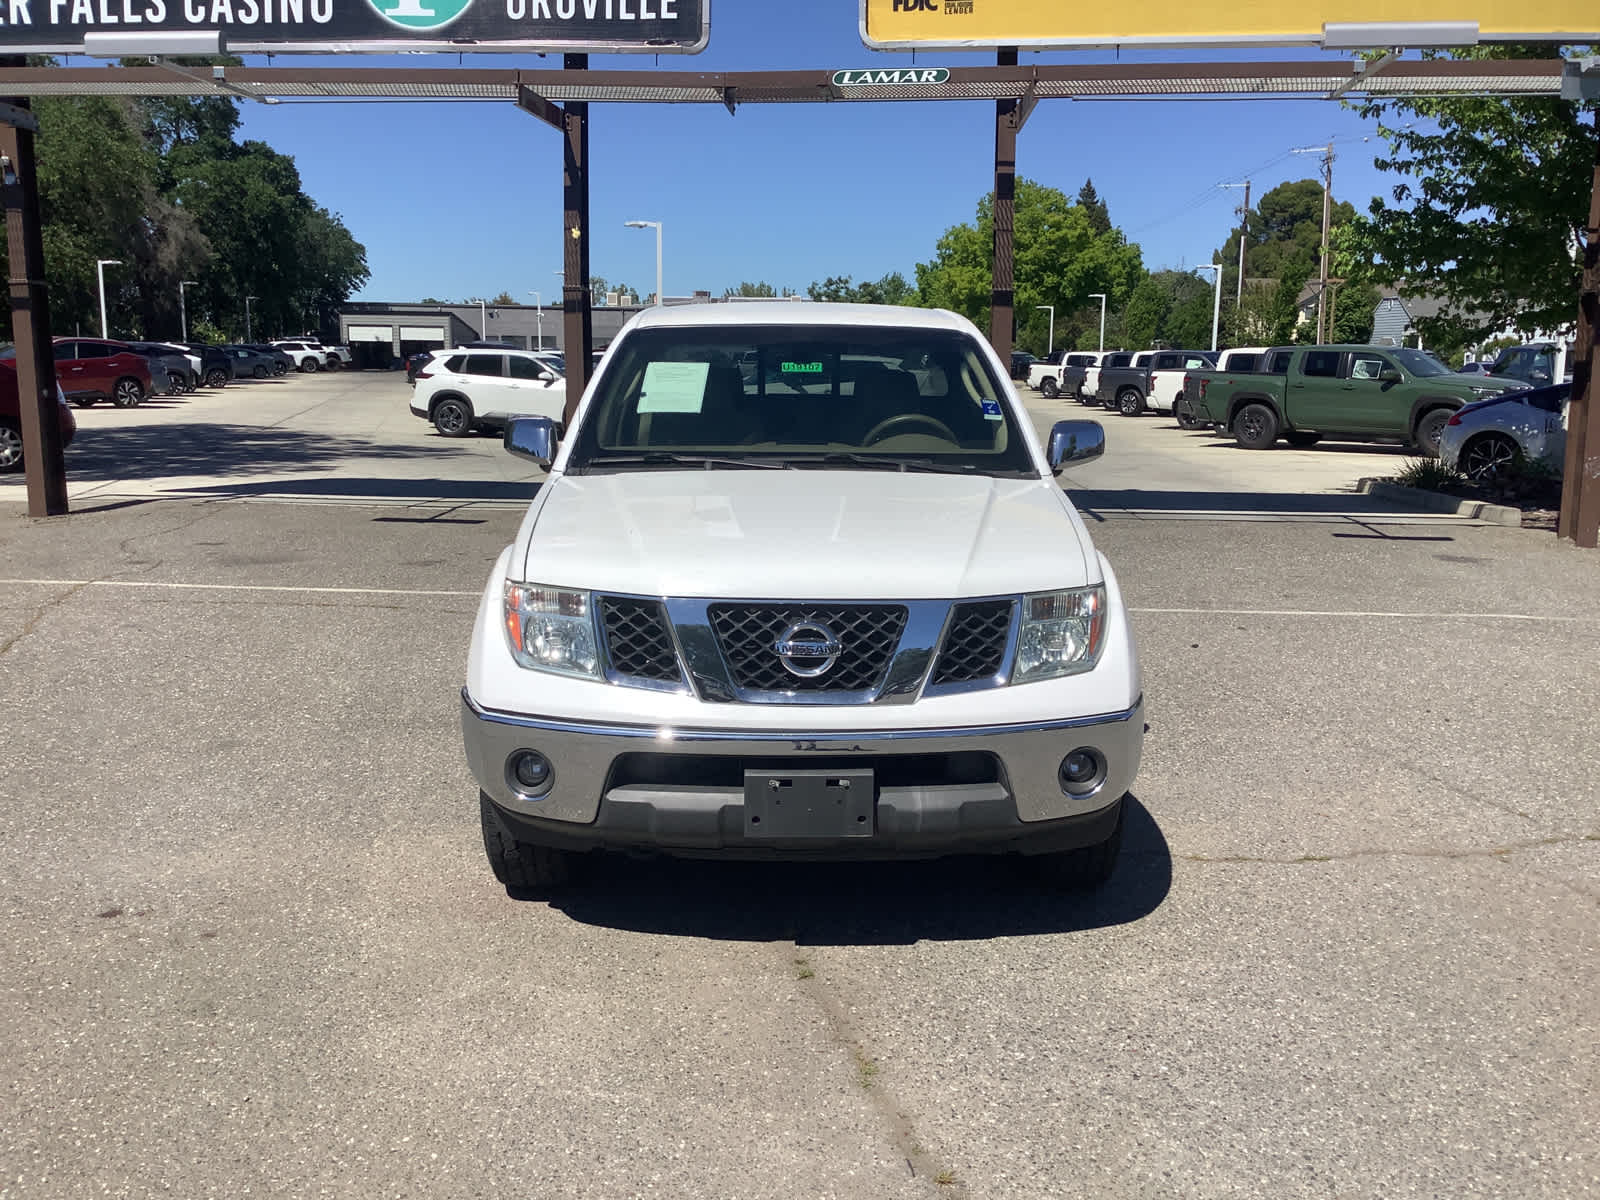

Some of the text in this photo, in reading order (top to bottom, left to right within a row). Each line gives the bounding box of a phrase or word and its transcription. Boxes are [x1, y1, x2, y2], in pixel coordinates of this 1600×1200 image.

[0, 0, 333, 24] R FALLS CASINO
[506, 0, 678, 20] OROVILLE
[842, 70, 938, 84] LAMAR
[780, 643, 837, 655] NISSAN
